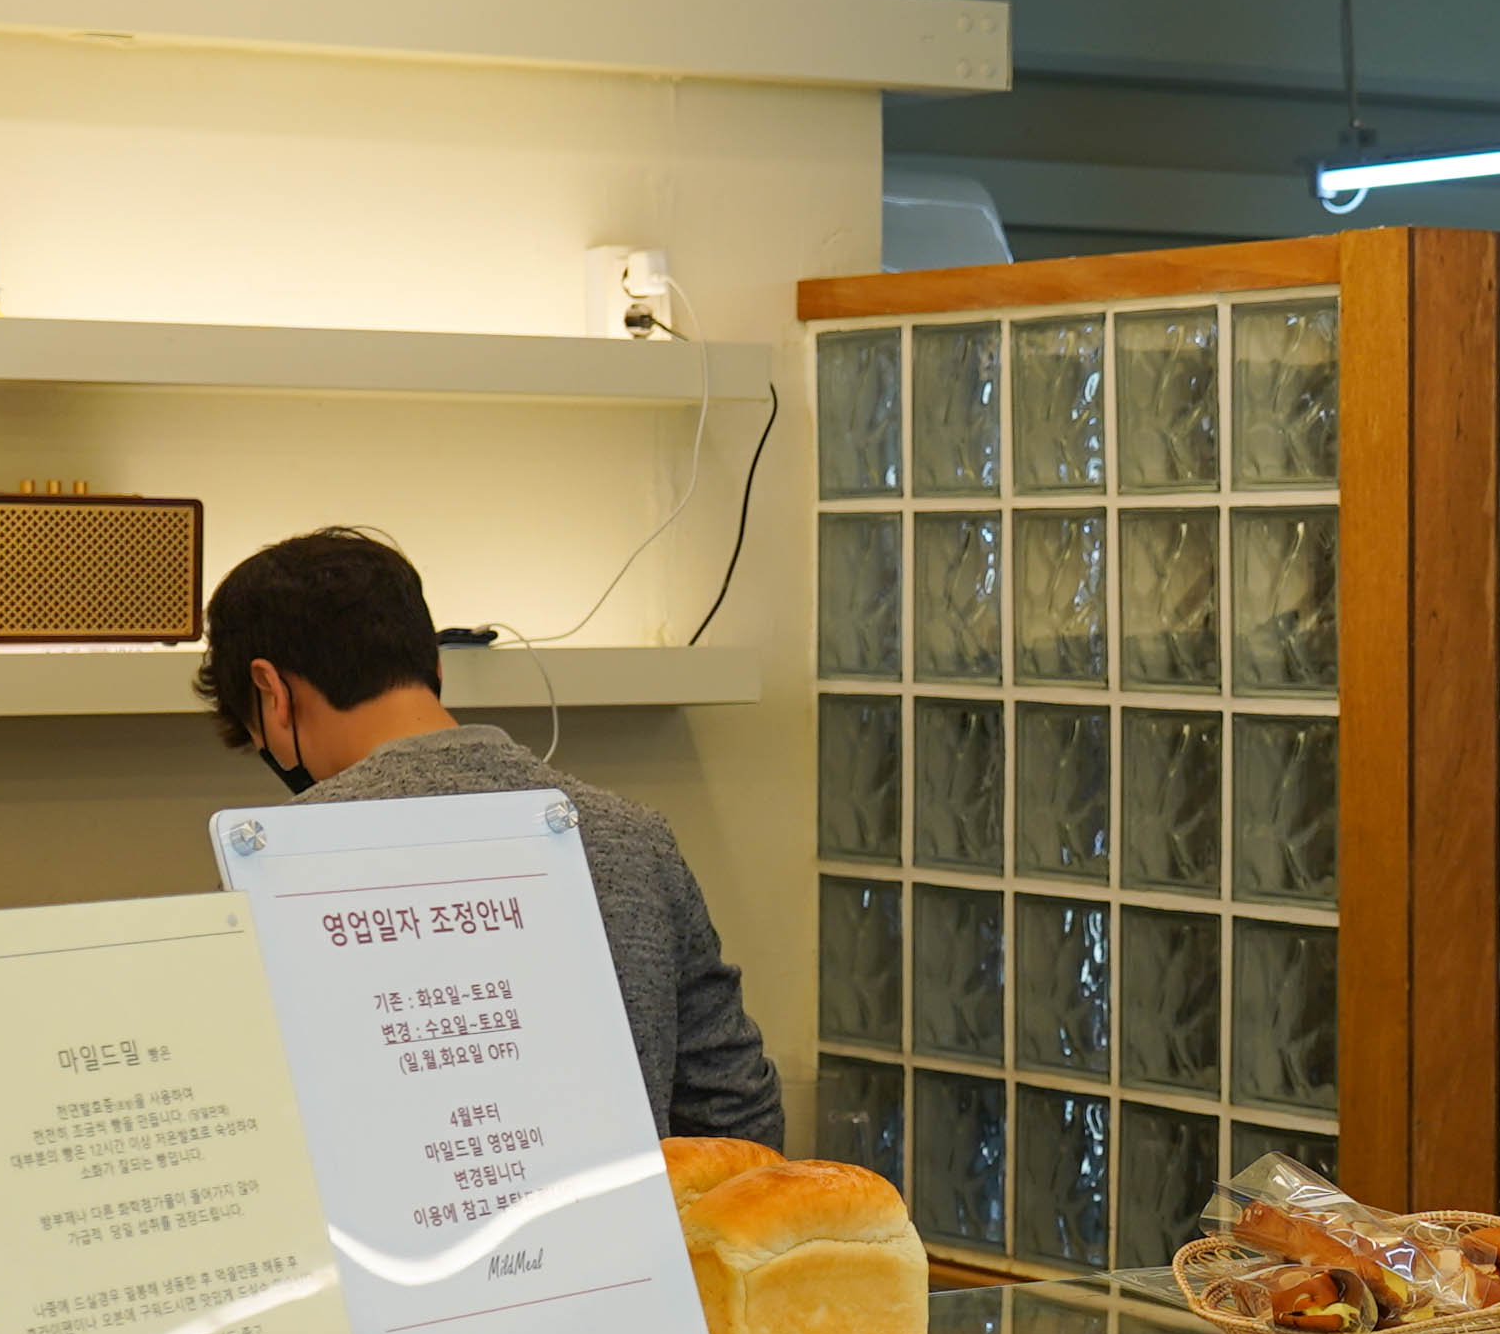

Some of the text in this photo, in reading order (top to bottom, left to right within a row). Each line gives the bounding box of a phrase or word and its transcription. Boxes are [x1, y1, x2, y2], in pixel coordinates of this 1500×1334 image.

[322, 897, 524, 947] 영업일자 조정안내
[373, 979, 513, 1014] 기존 화요일~토요일
[382, 1008, 521, 1044] 변경 수요일~토요일
[58, 1039, 141, 1074] 마일드밀
[399, 1041, 520, 1075] (일,월,화요일 OFF)
[450, 1102, 501, 1127] 4월부터
[424, 1127, 544, 1162] 마일드밀 영업일이
[453, 1161, 526, 1190] 변경됩니다
[413, 1202, 458, 1227] 이용에
[462, 1199, 492, 1220] 참고
[488, 1247, 544, 1280] MildMeal
